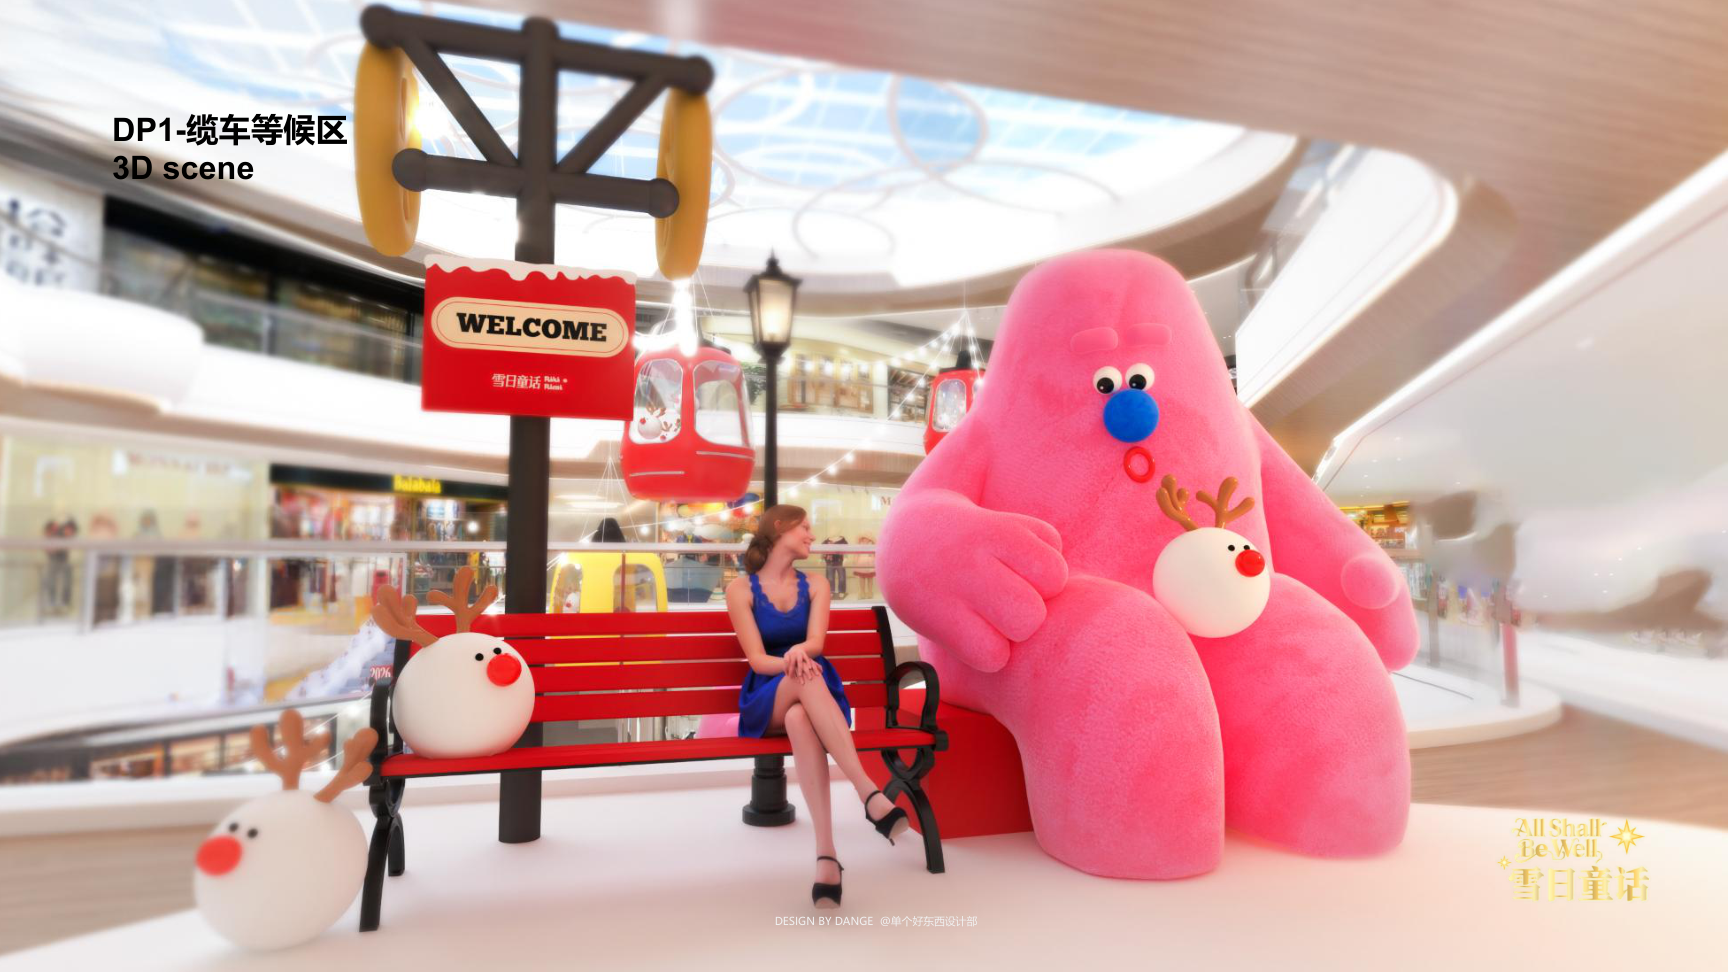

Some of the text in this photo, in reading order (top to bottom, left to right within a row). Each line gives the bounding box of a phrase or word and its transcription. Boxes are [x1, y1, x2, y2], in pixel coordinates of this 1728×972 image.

[456, 312, 607, 342] WELCOME
[491, 373, 541, 390] 雪日童话
